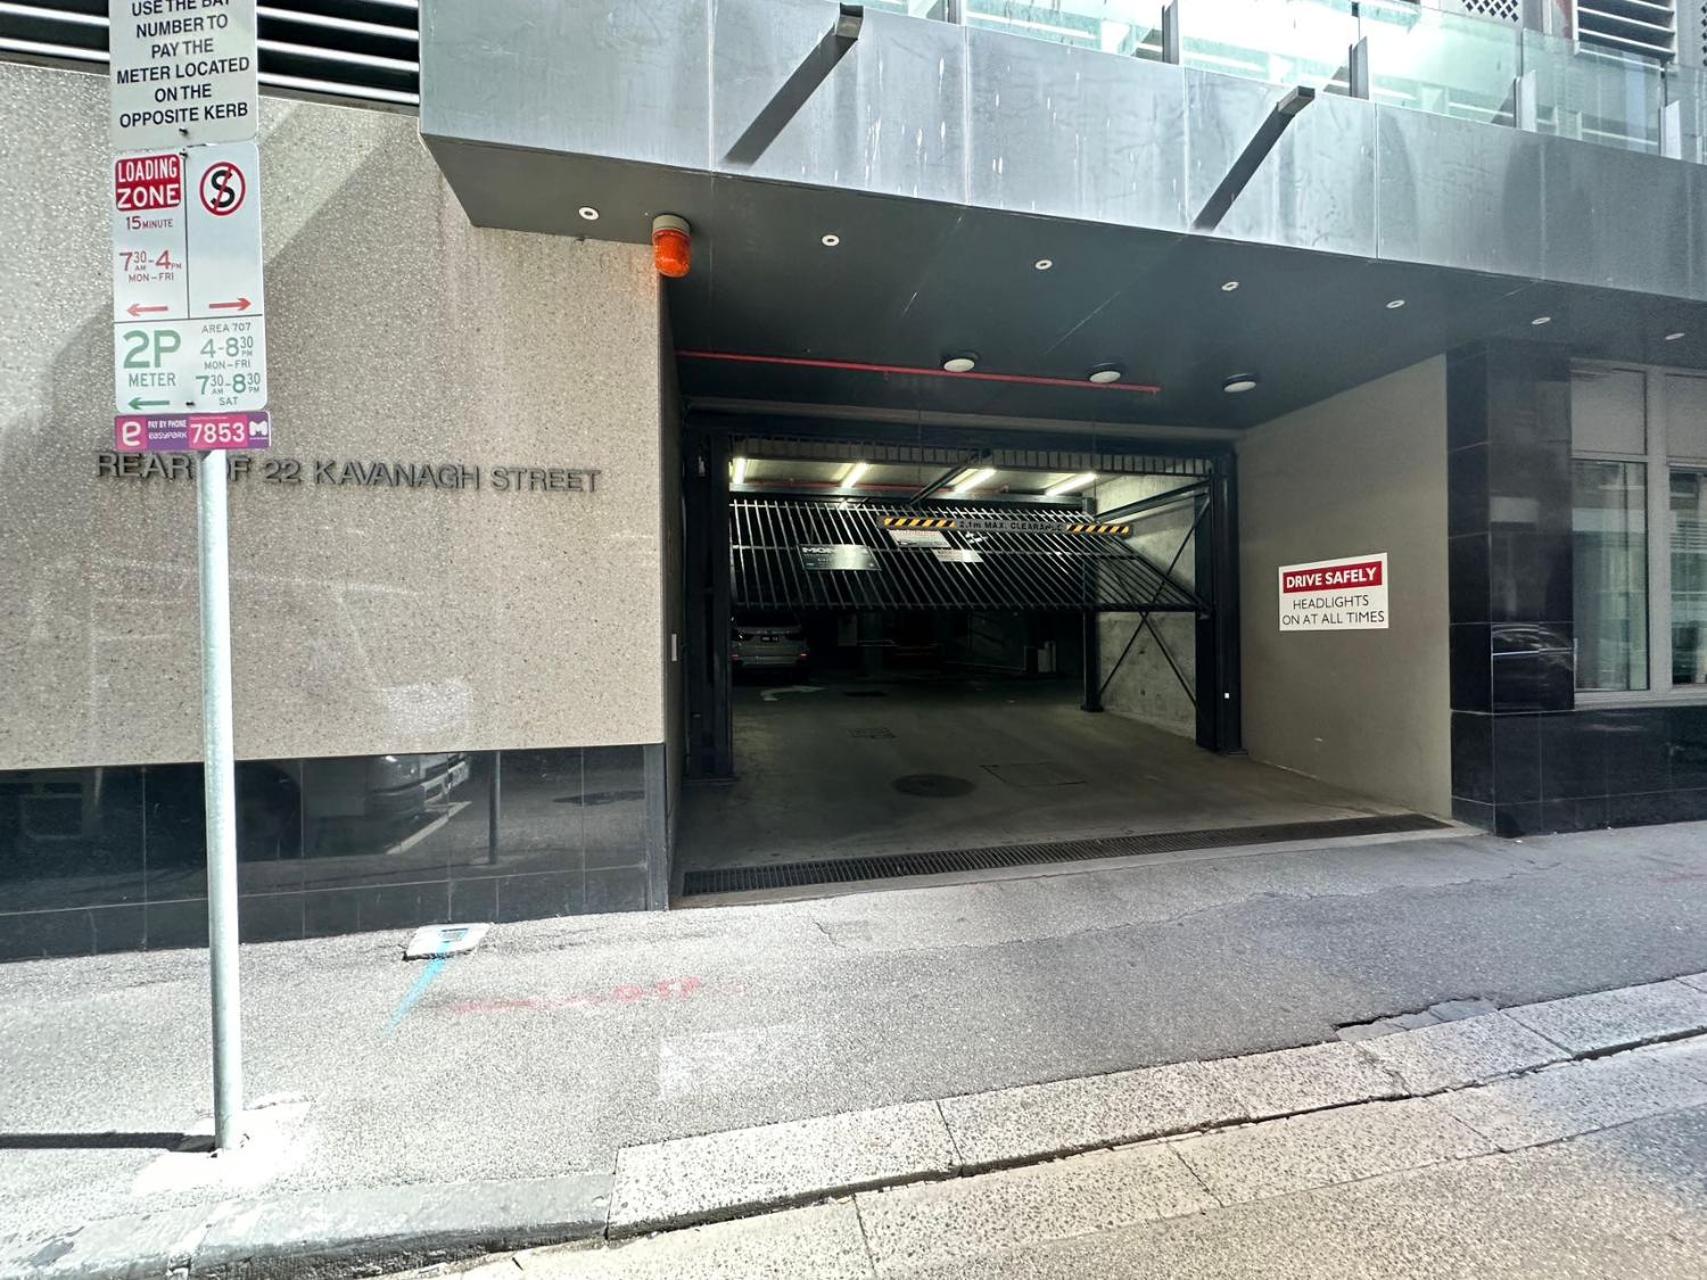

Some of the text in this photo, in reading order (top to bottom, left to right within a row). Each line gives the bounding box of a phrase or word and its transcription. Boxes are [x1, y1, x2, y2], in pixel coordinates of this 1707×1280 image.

[132, 0, 162, 16] USE
[136, 14, 228, 38] NUMBER TO
[151, 38, 214, 59] PAY THE
[117, 56, 250, 84] METER LOCATED
[154, 83, 212, 103] ON THE
[119, 102, 248, 128] OPPOSITE KERB
[118, 157, 177, 183] LOADING
[117, 184, 180, 209] ZONE
[201, 322, 251, 334] AREA 707
[123, 330, 181, 369] 2P
[128, 373, 176, 388] METER
[219, 397, 239, 406] SAT
[190, 422, 245, 443] 7853
[96, 452, 193, 480] REAR
[263, 459, 302, 483] 22
[314, 460, 480, 490] KAVANAGH
[492, 466, 601, 492] STREET
[1286, 567, 1377, 588] DRIVE SAFELY
[1293, 595, 1369, 610] HEADLIGHTS
[1282, 610, 1385, 625] ON AT ALL TIMES
